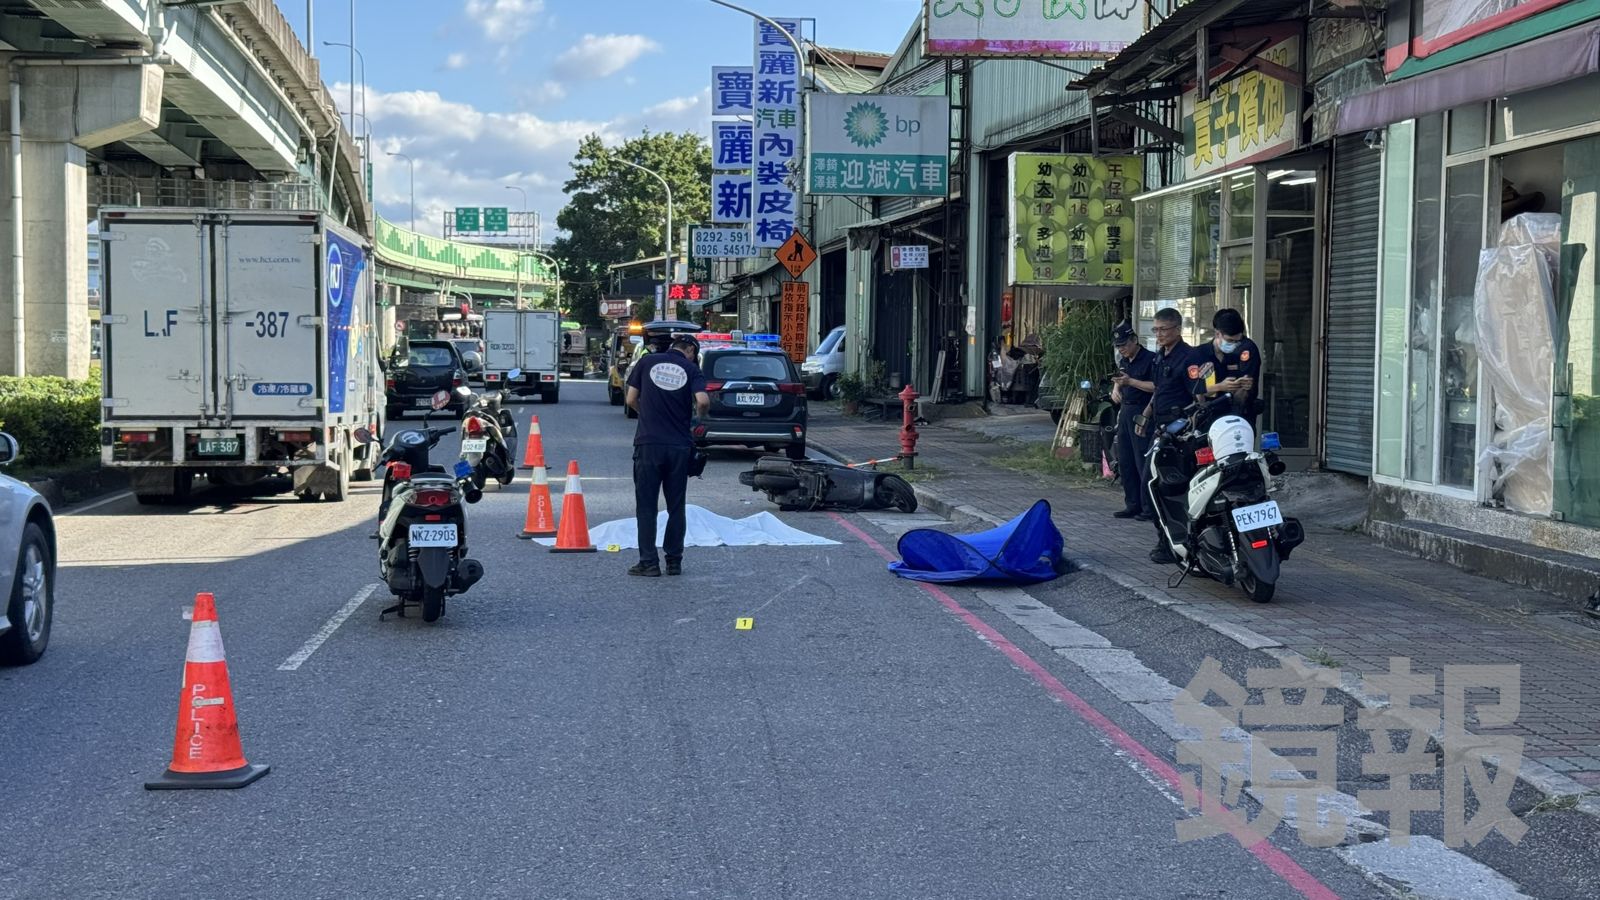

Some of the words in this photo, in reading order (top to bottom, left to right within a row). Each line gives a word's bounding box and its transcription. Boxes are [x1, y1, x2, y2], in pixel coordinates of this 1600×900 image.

[895, 115, 921, 137] bp
[840, 159, 943, 190] 迎斌汽車
[1036, 203, 1052, 214] 12
[1071, 203, 1088, 215] 16
[696, 231, 749, 243] 8292-591
[1035, 267, 1052, 278] 18
[1105, 268, 1121, 279] 22
[783, 283, 795, 360] 請依指示小心行
[1235, 506, 1277, 527] PEK-7967
[411, 528, 456, 543] NKZ-2903
[189, 683, 206, 760] POLICE
